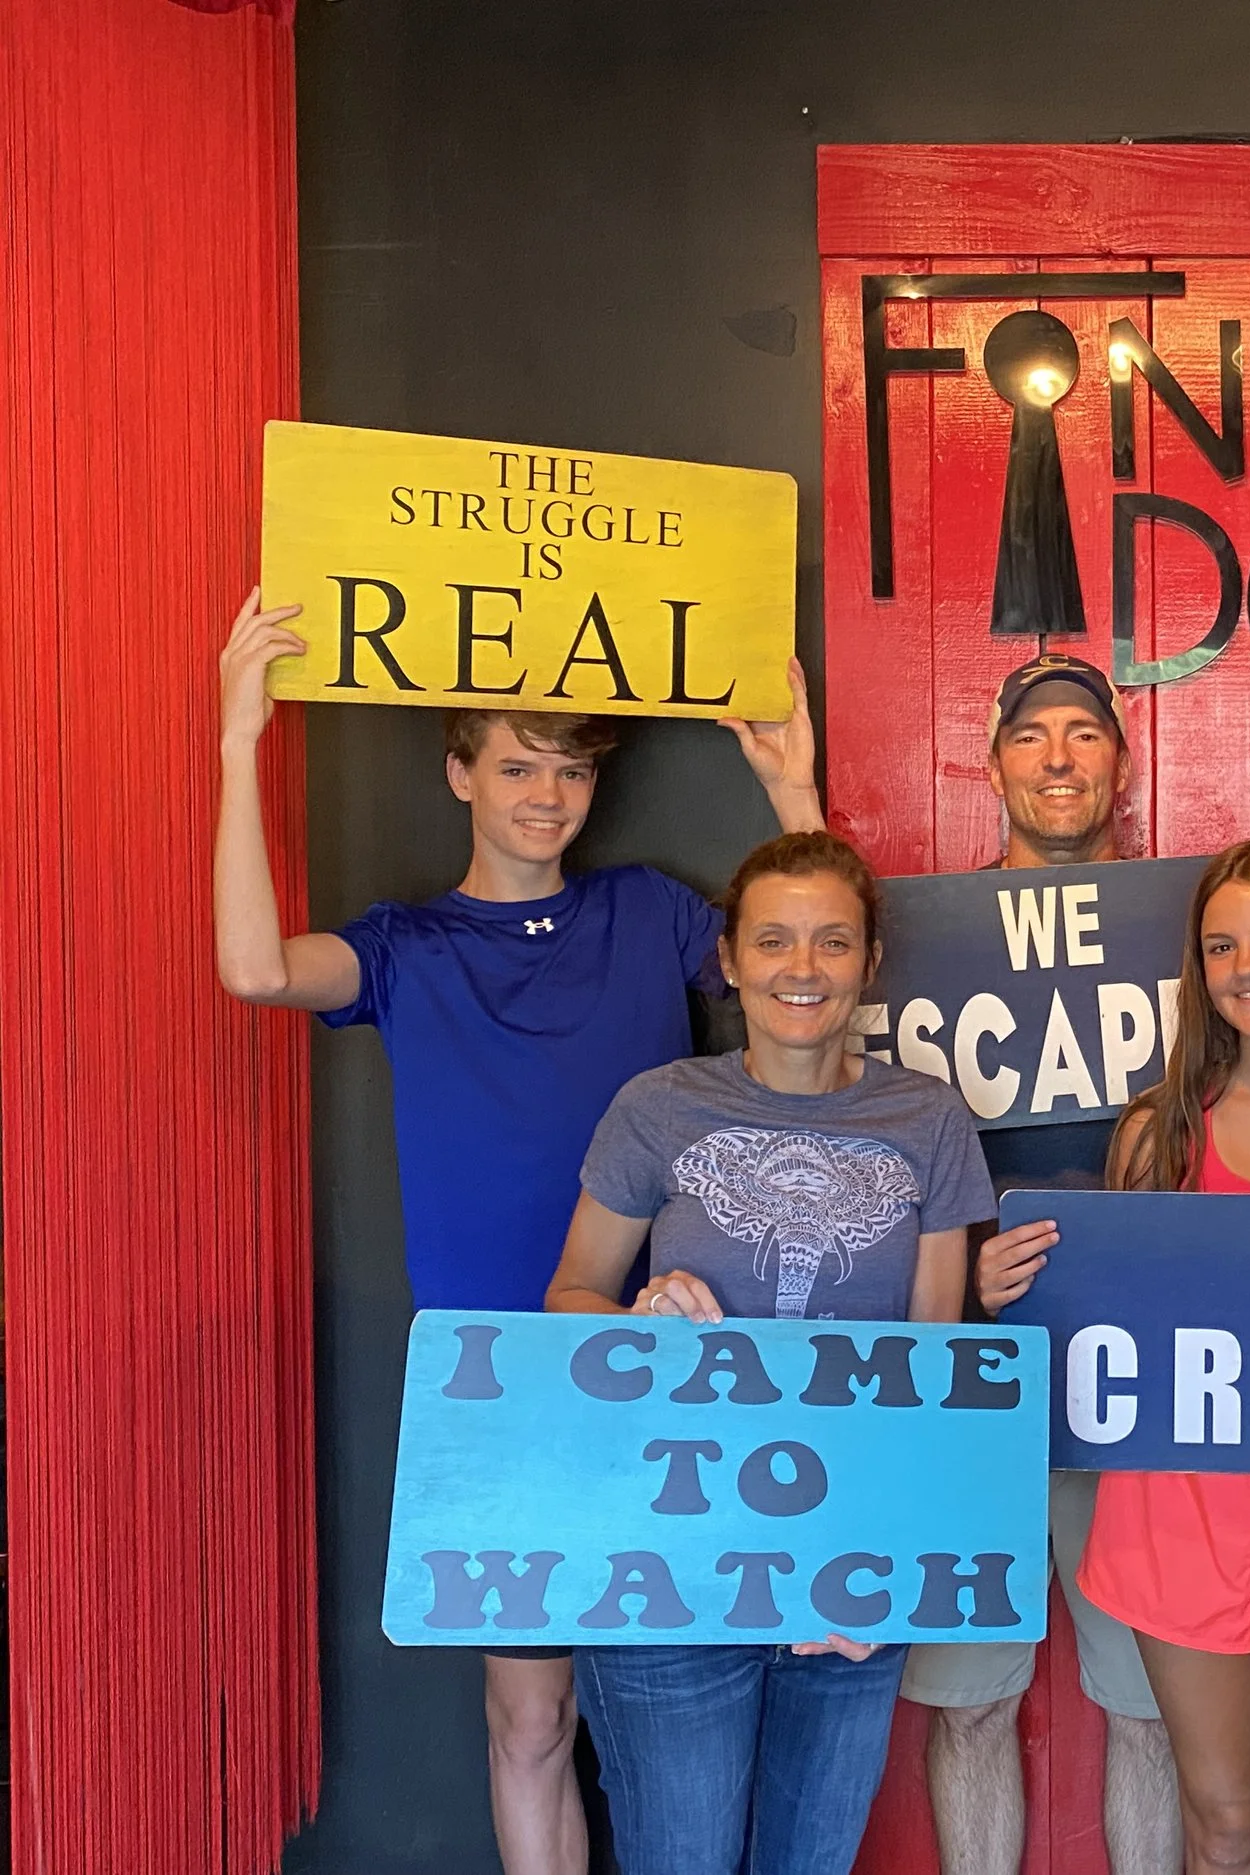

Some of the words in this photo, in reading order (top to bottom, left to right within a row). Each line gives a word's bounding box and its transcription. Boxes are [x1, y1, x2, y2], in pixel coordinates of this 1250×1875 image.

[489, 451, 595, 496] THE
[390, 486, 684, 547] STRUGGLE
[521, 542, 563, 580] IS
[325, 575, 736, 706] REAL
[998, 883, 1104, 971] WE
[844, 978, 1181, 1119] SCAP
[441, 1325, 504, 1400] I
[569, 1328, 1021, 1409] CAME
[642, 1439, 828, 1517] TO
[421, 1550, 1022, 1629] WATCH
